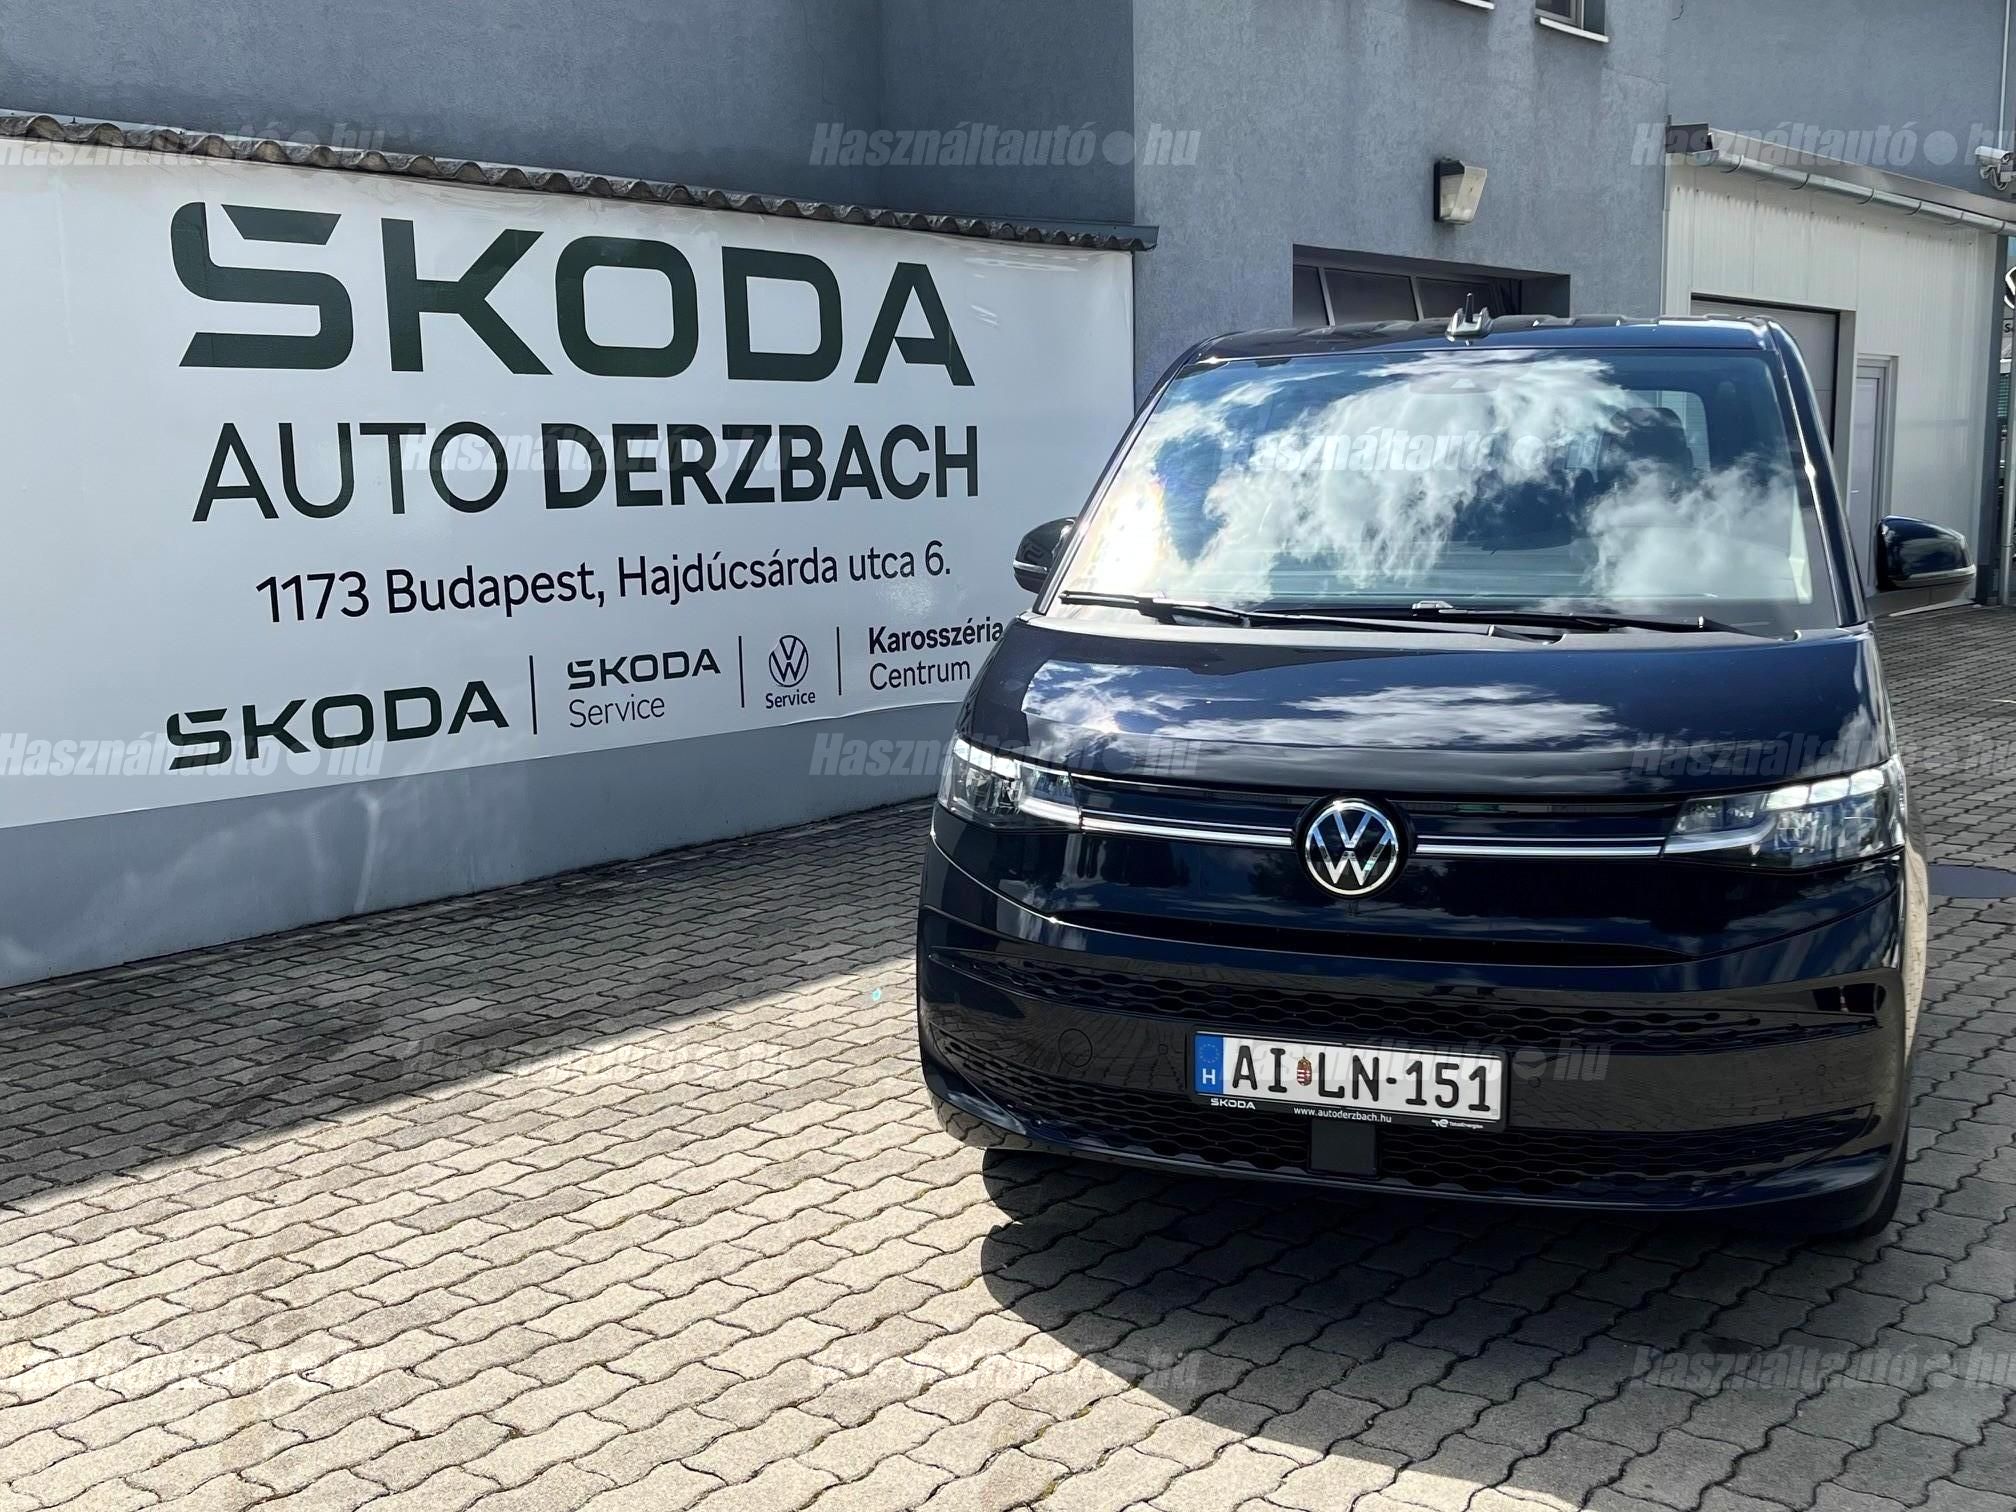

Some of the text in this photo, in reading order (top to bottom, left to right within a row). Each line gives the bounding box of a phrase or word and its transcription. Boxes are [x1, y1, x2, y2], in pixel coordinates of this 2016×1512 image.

[192, 420, 980, 523] AUTO DERZBACH
[255, 540, 952, 623] 1173 Budapest, Hajdúcsárda utca 6.
[868, 616, 1004, 655] Karosszéria
[869, 659, 972, 691] Centrum
[569, 692, 666, 728] Service
[765, 688, 816, 710] Service
[1201, 1067, 1217, 1086] H
[1293, 1107, 1392, 1123] www.autoderzbach.hu
